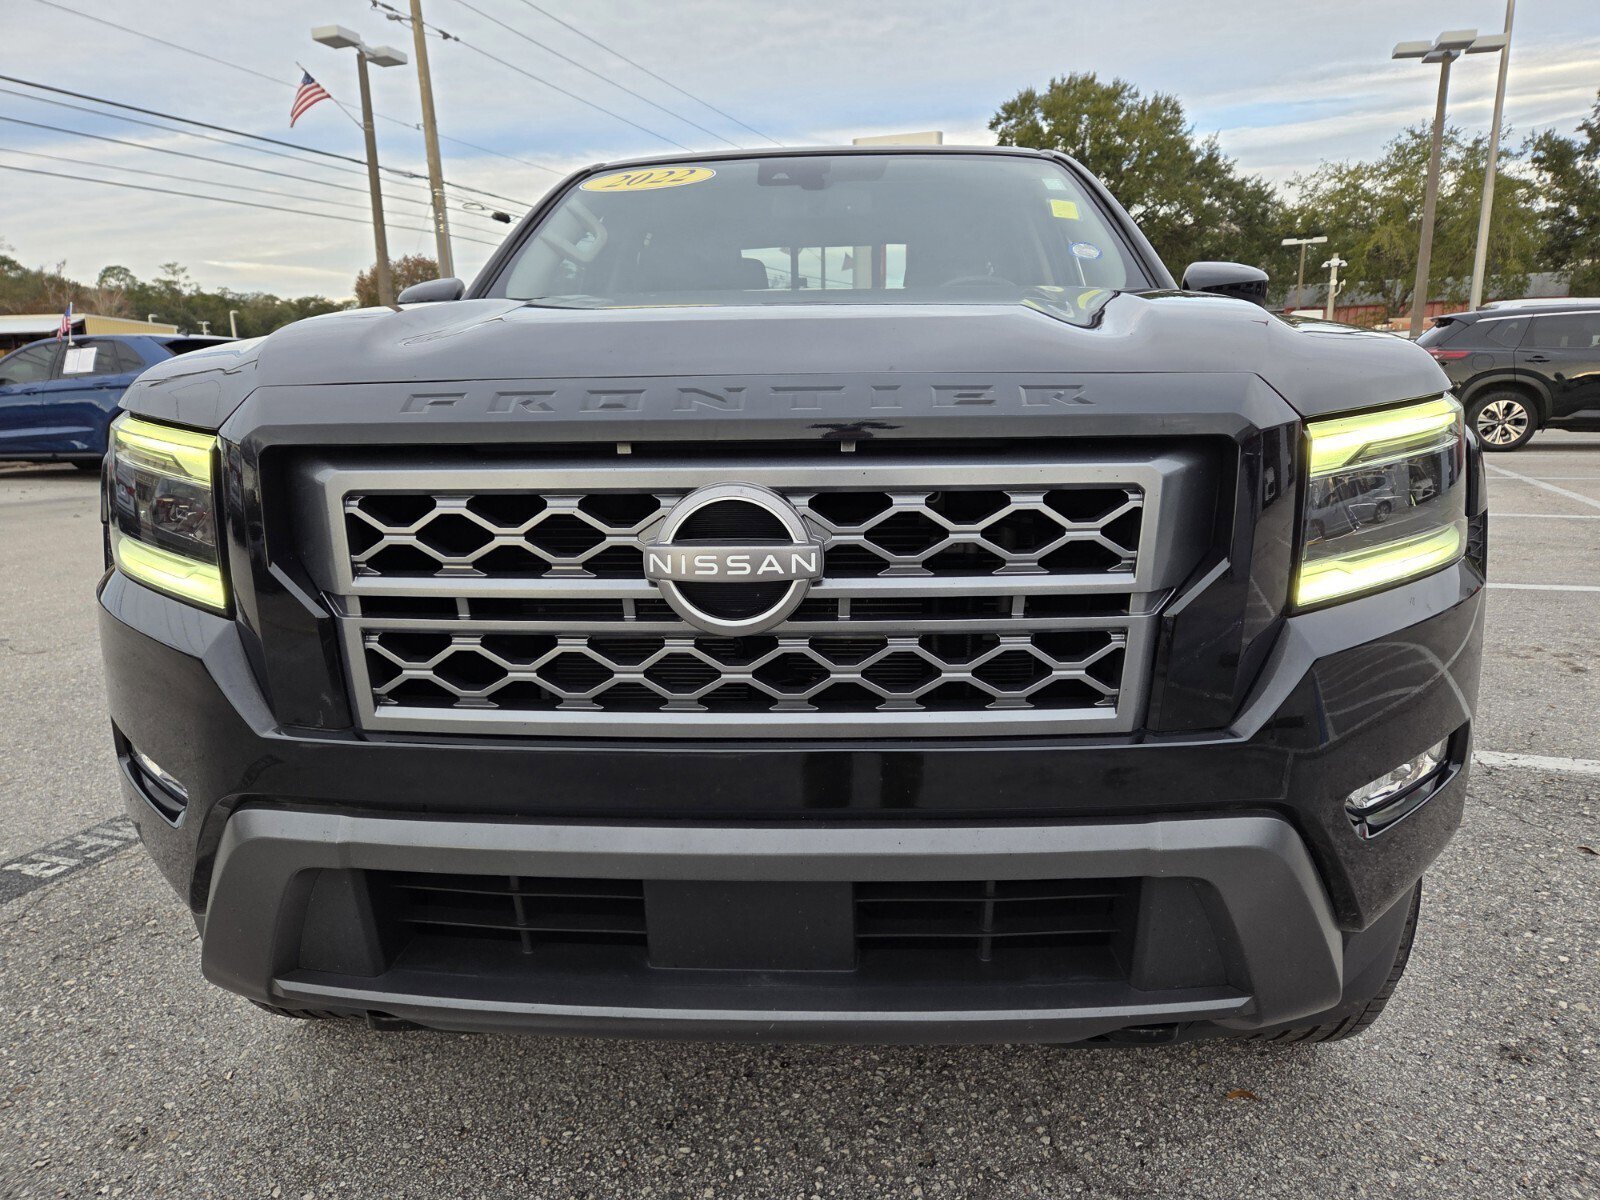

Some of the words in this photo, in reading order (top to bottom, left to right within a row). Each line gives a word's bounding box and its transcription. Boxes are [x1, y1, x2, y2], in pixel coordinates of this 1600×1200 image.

[601, 169, 697, 188] 2022
[400, 384, 1097, 413] FRONTIER
[649, 552, 816, 575] NISSAN
